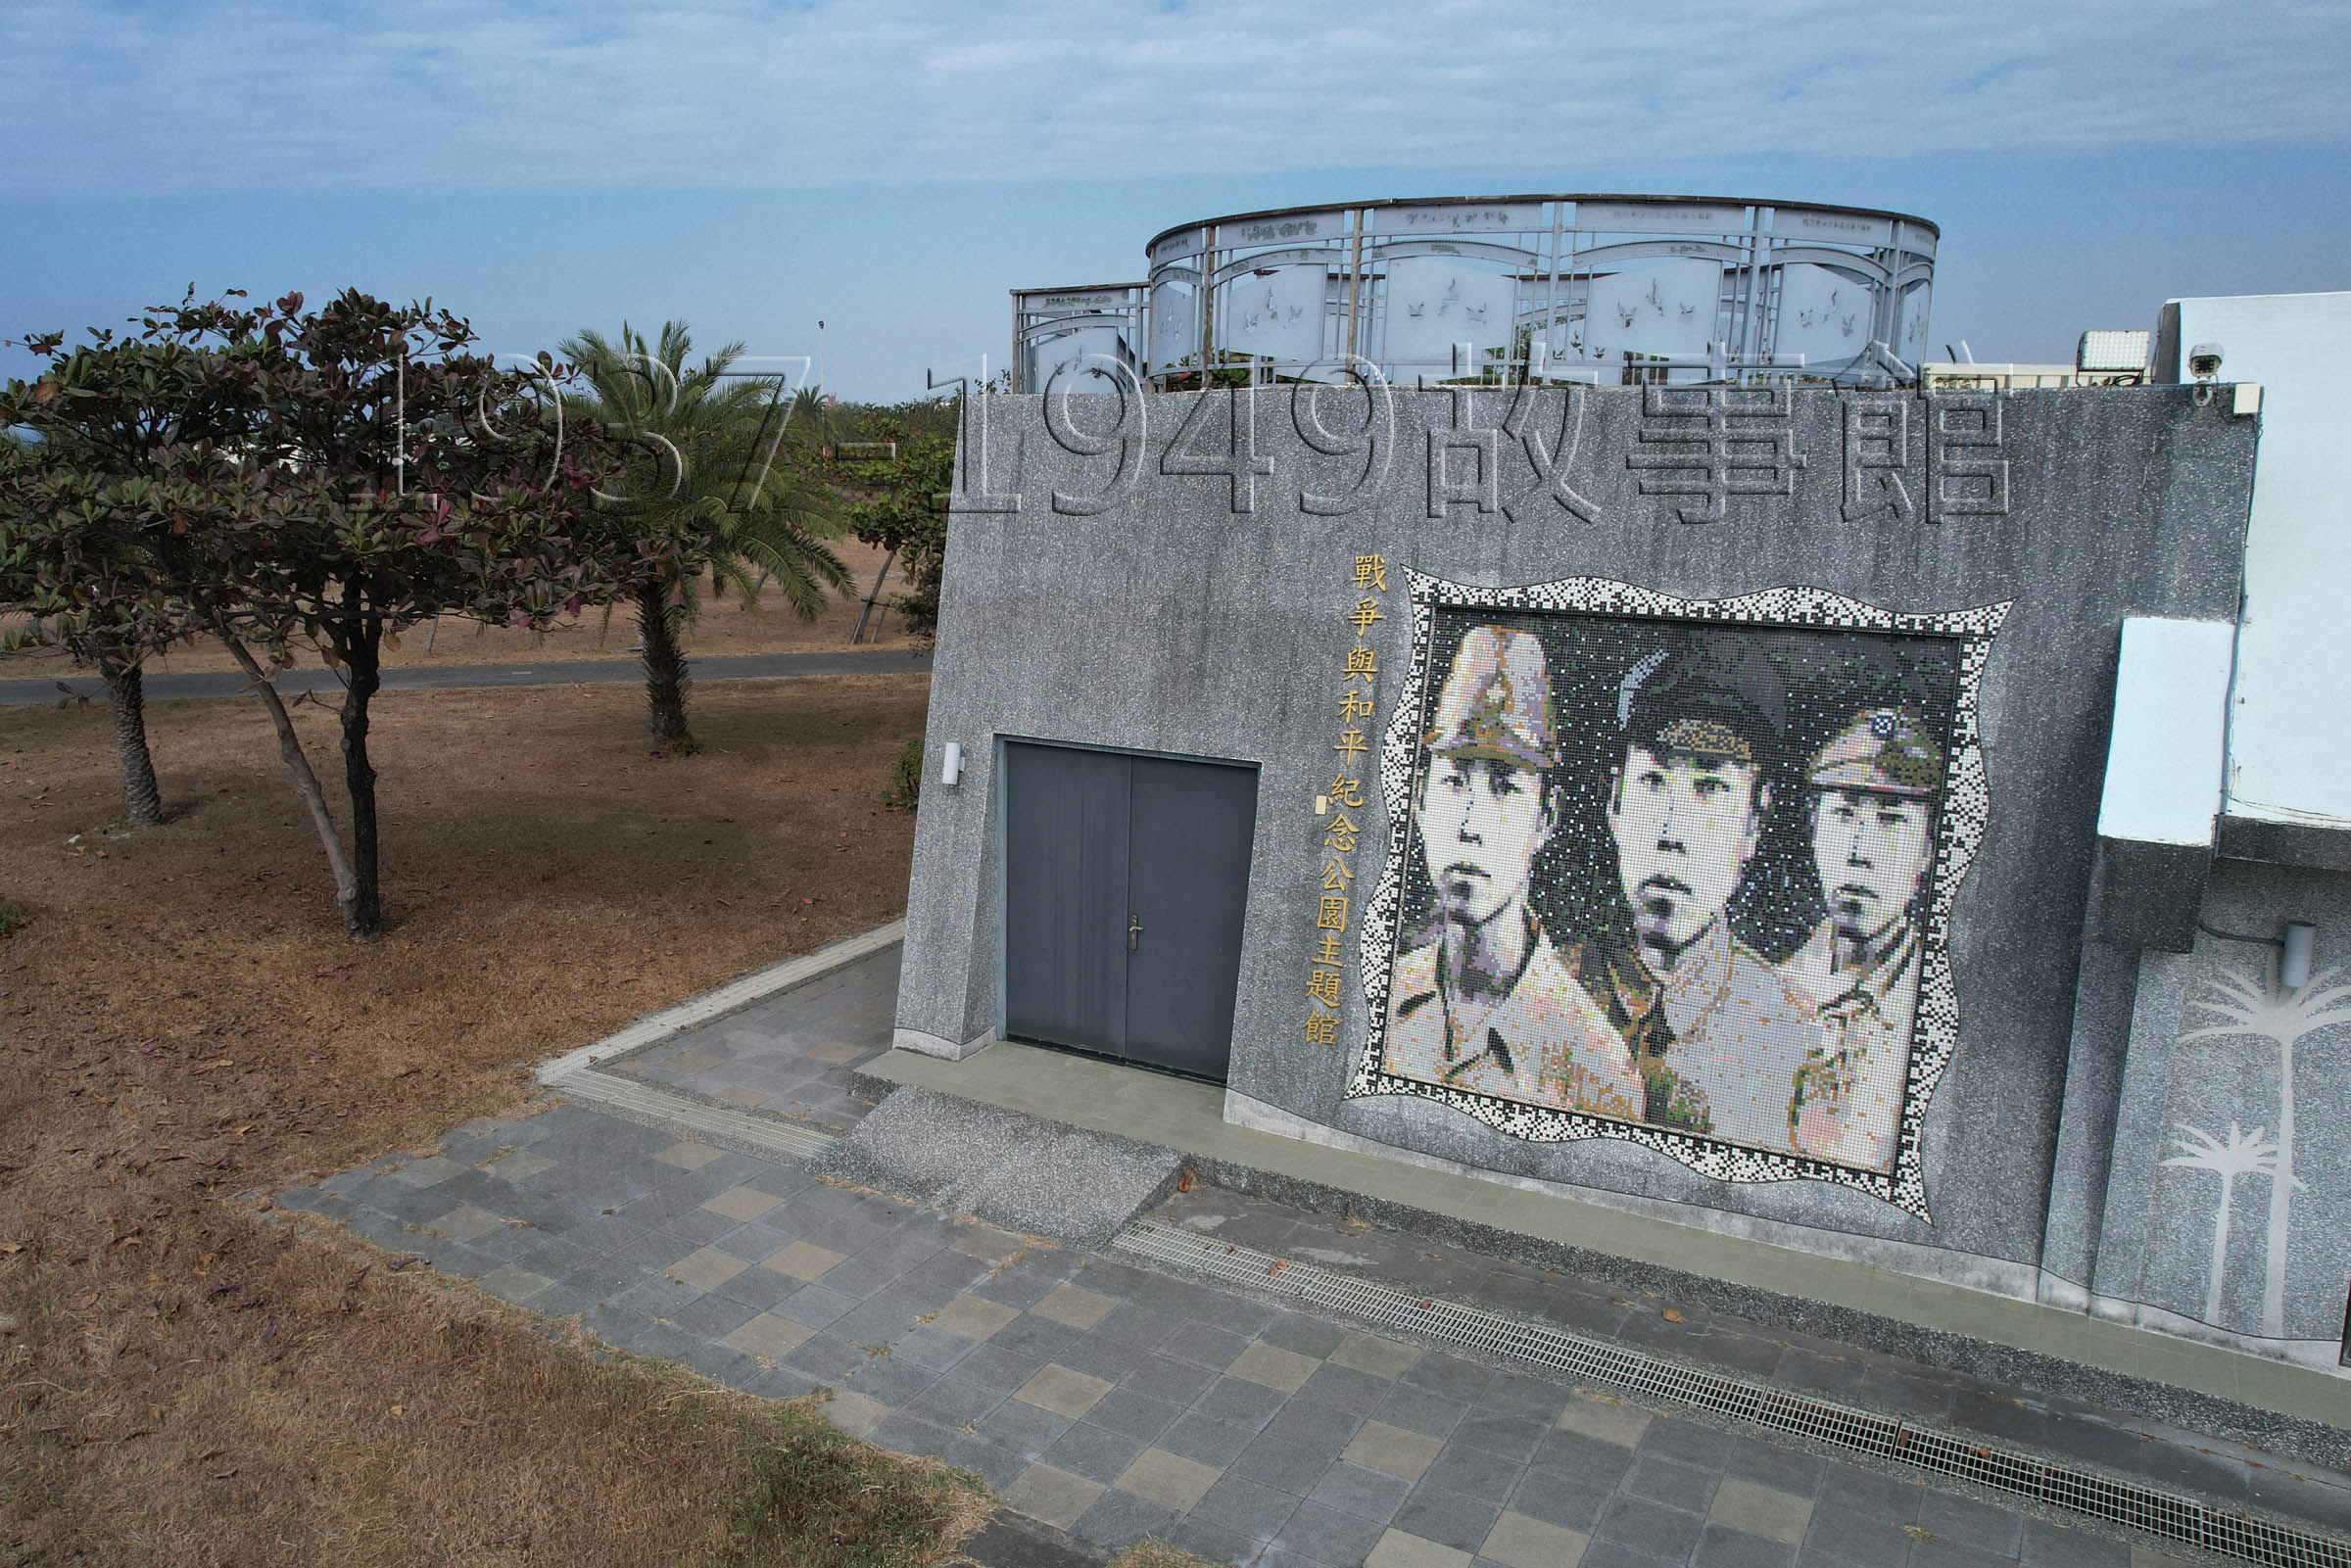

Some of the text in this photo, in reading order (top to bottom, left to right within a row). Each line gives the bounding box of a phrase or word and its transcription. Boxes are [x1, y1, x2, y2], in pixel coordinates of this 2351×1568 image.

[1304, 553, 1387, 1046] 戰爭與和平紀念公園主題館
